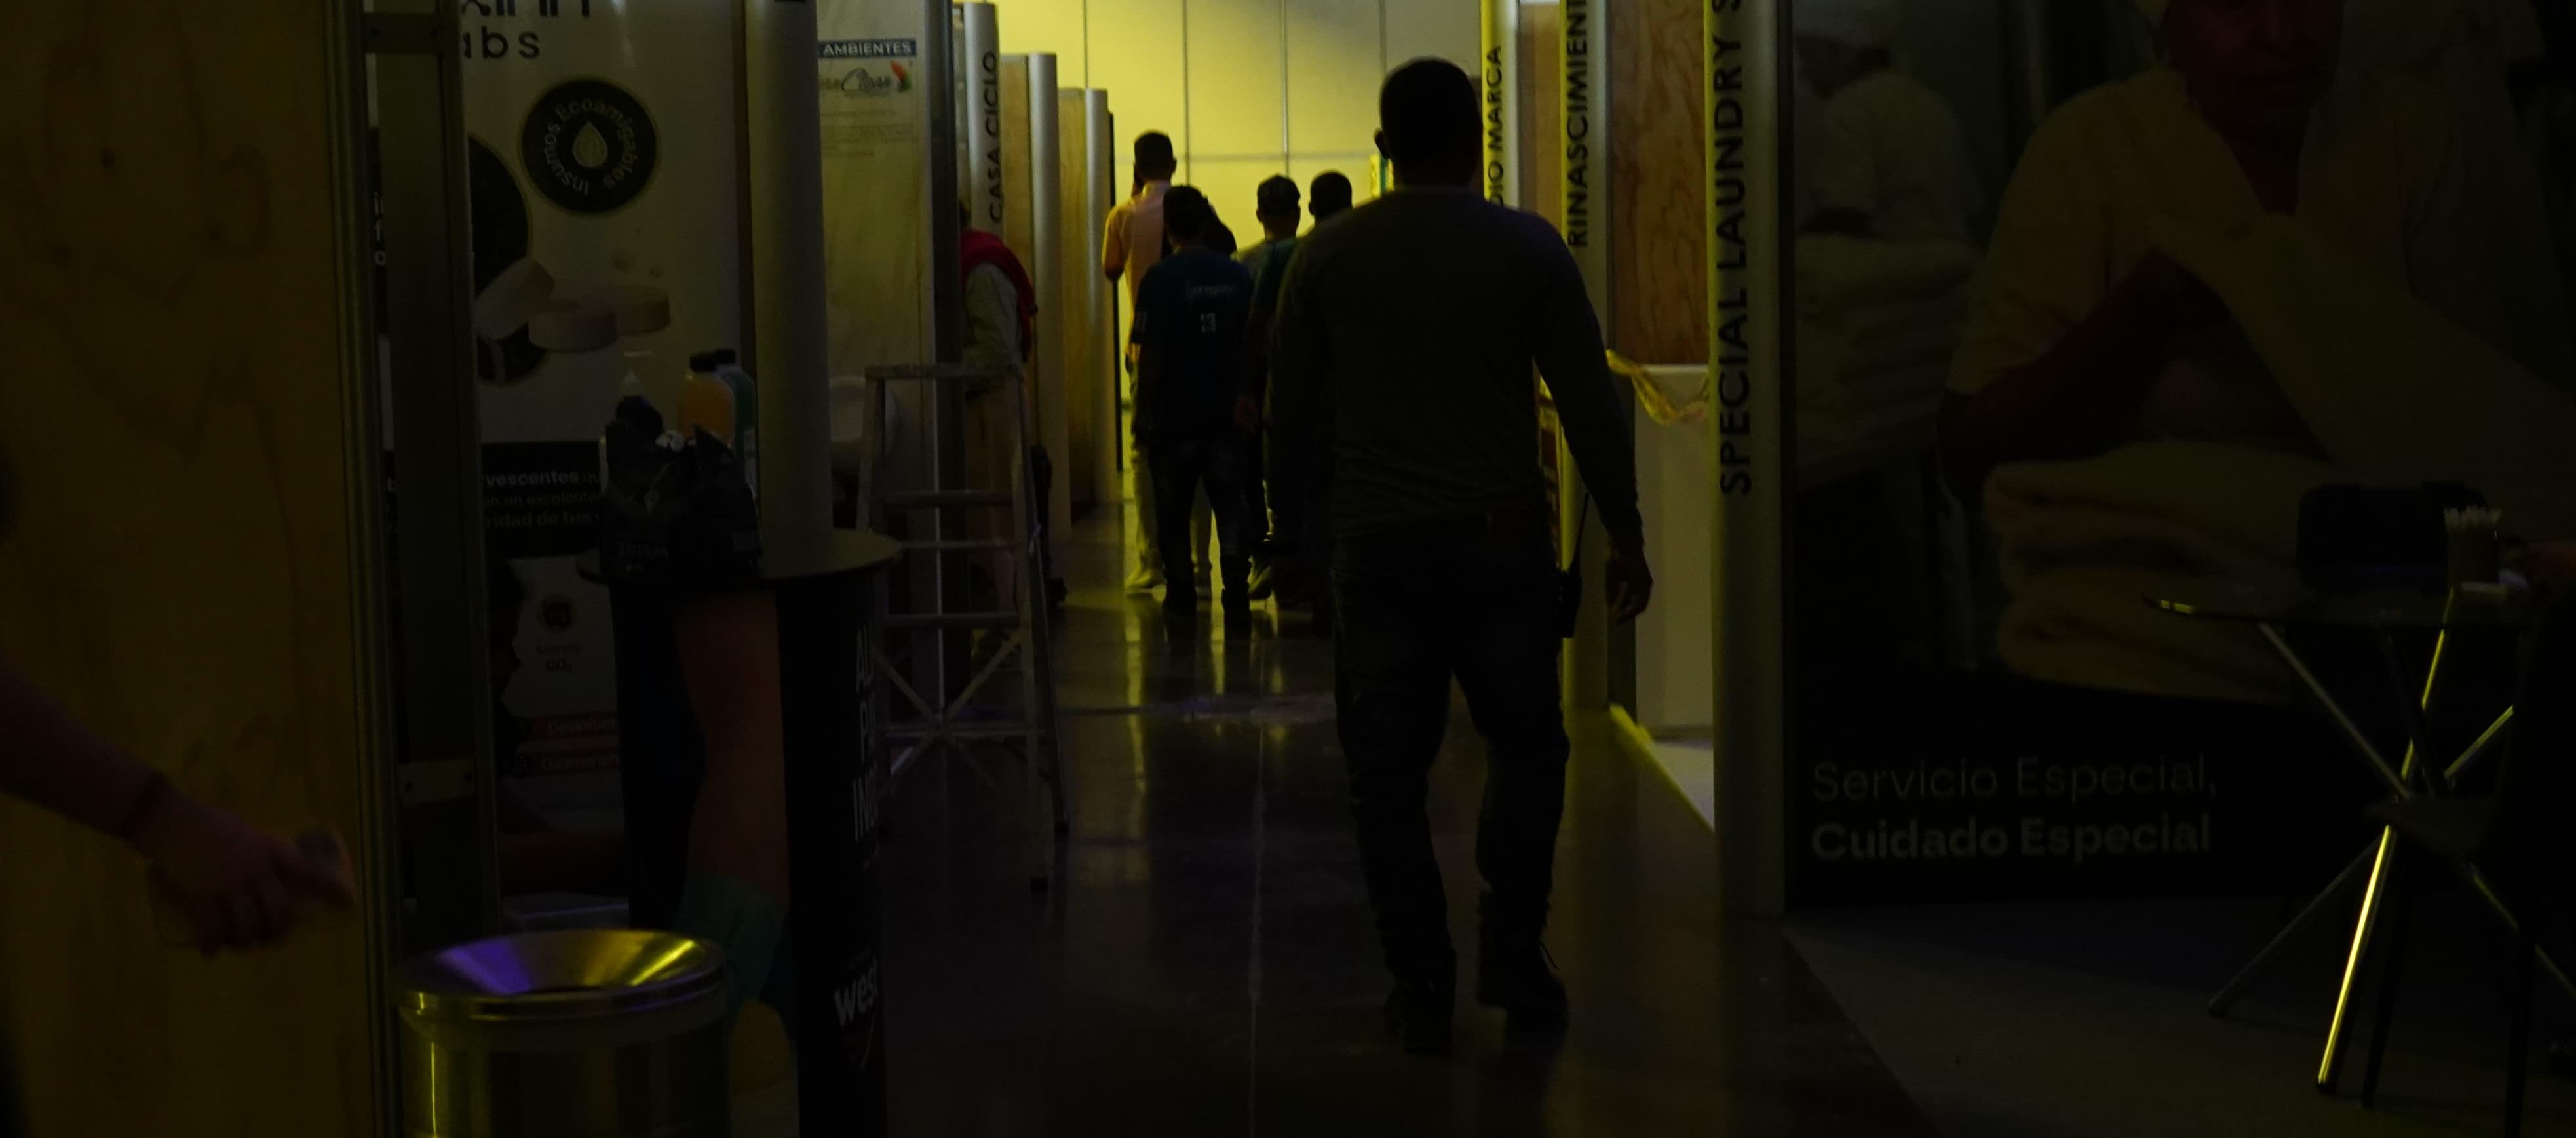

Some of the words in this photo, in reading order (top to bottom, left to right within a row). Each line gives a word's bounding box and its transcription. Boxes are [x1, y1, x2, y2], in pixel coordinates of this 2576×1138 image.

[823, 41, 912, 56] AMBIENTES
[1486, 47, 1503, 151] MARCA
[545, 121, 589, 197] Insumos
[986, 147, 1003, 224] CASA
[1714, 39, 1747, 271] LAUNDRY
[1719, 289, 1750, 496] SPECIAL
[1813, 758, 1998, 802] Servicio
[2016, 750, 2217, 808] Especial,
[1811, 817, 2008, 861] Cuidado
[2020, 811, 2210, 866] Especial
